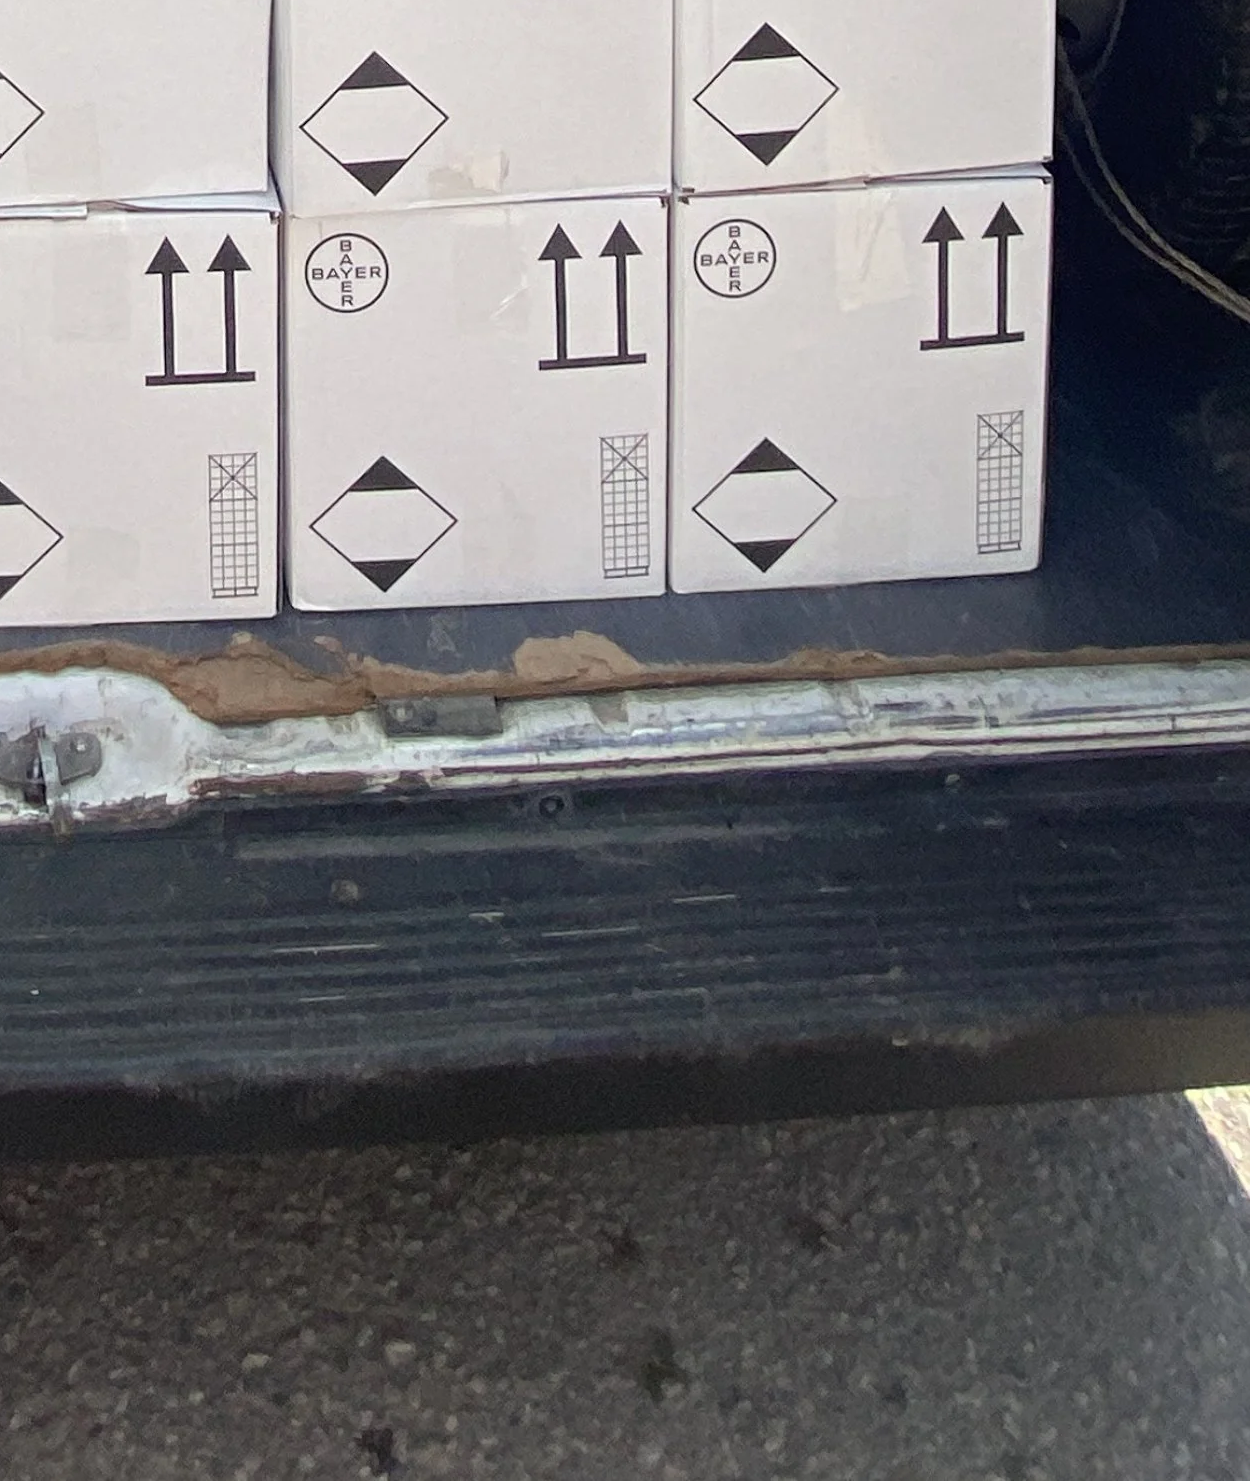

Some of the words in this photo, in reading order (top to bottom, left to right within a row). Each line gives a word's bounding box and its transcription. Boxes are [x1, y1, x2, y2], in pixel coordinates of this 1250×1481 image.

[311, 265, 382, 281] BAYER
[337, 240, 353, 306] BAYER
[700, 251, 770, 266] BAYER
[726, 226, 741, 291] BAYER
